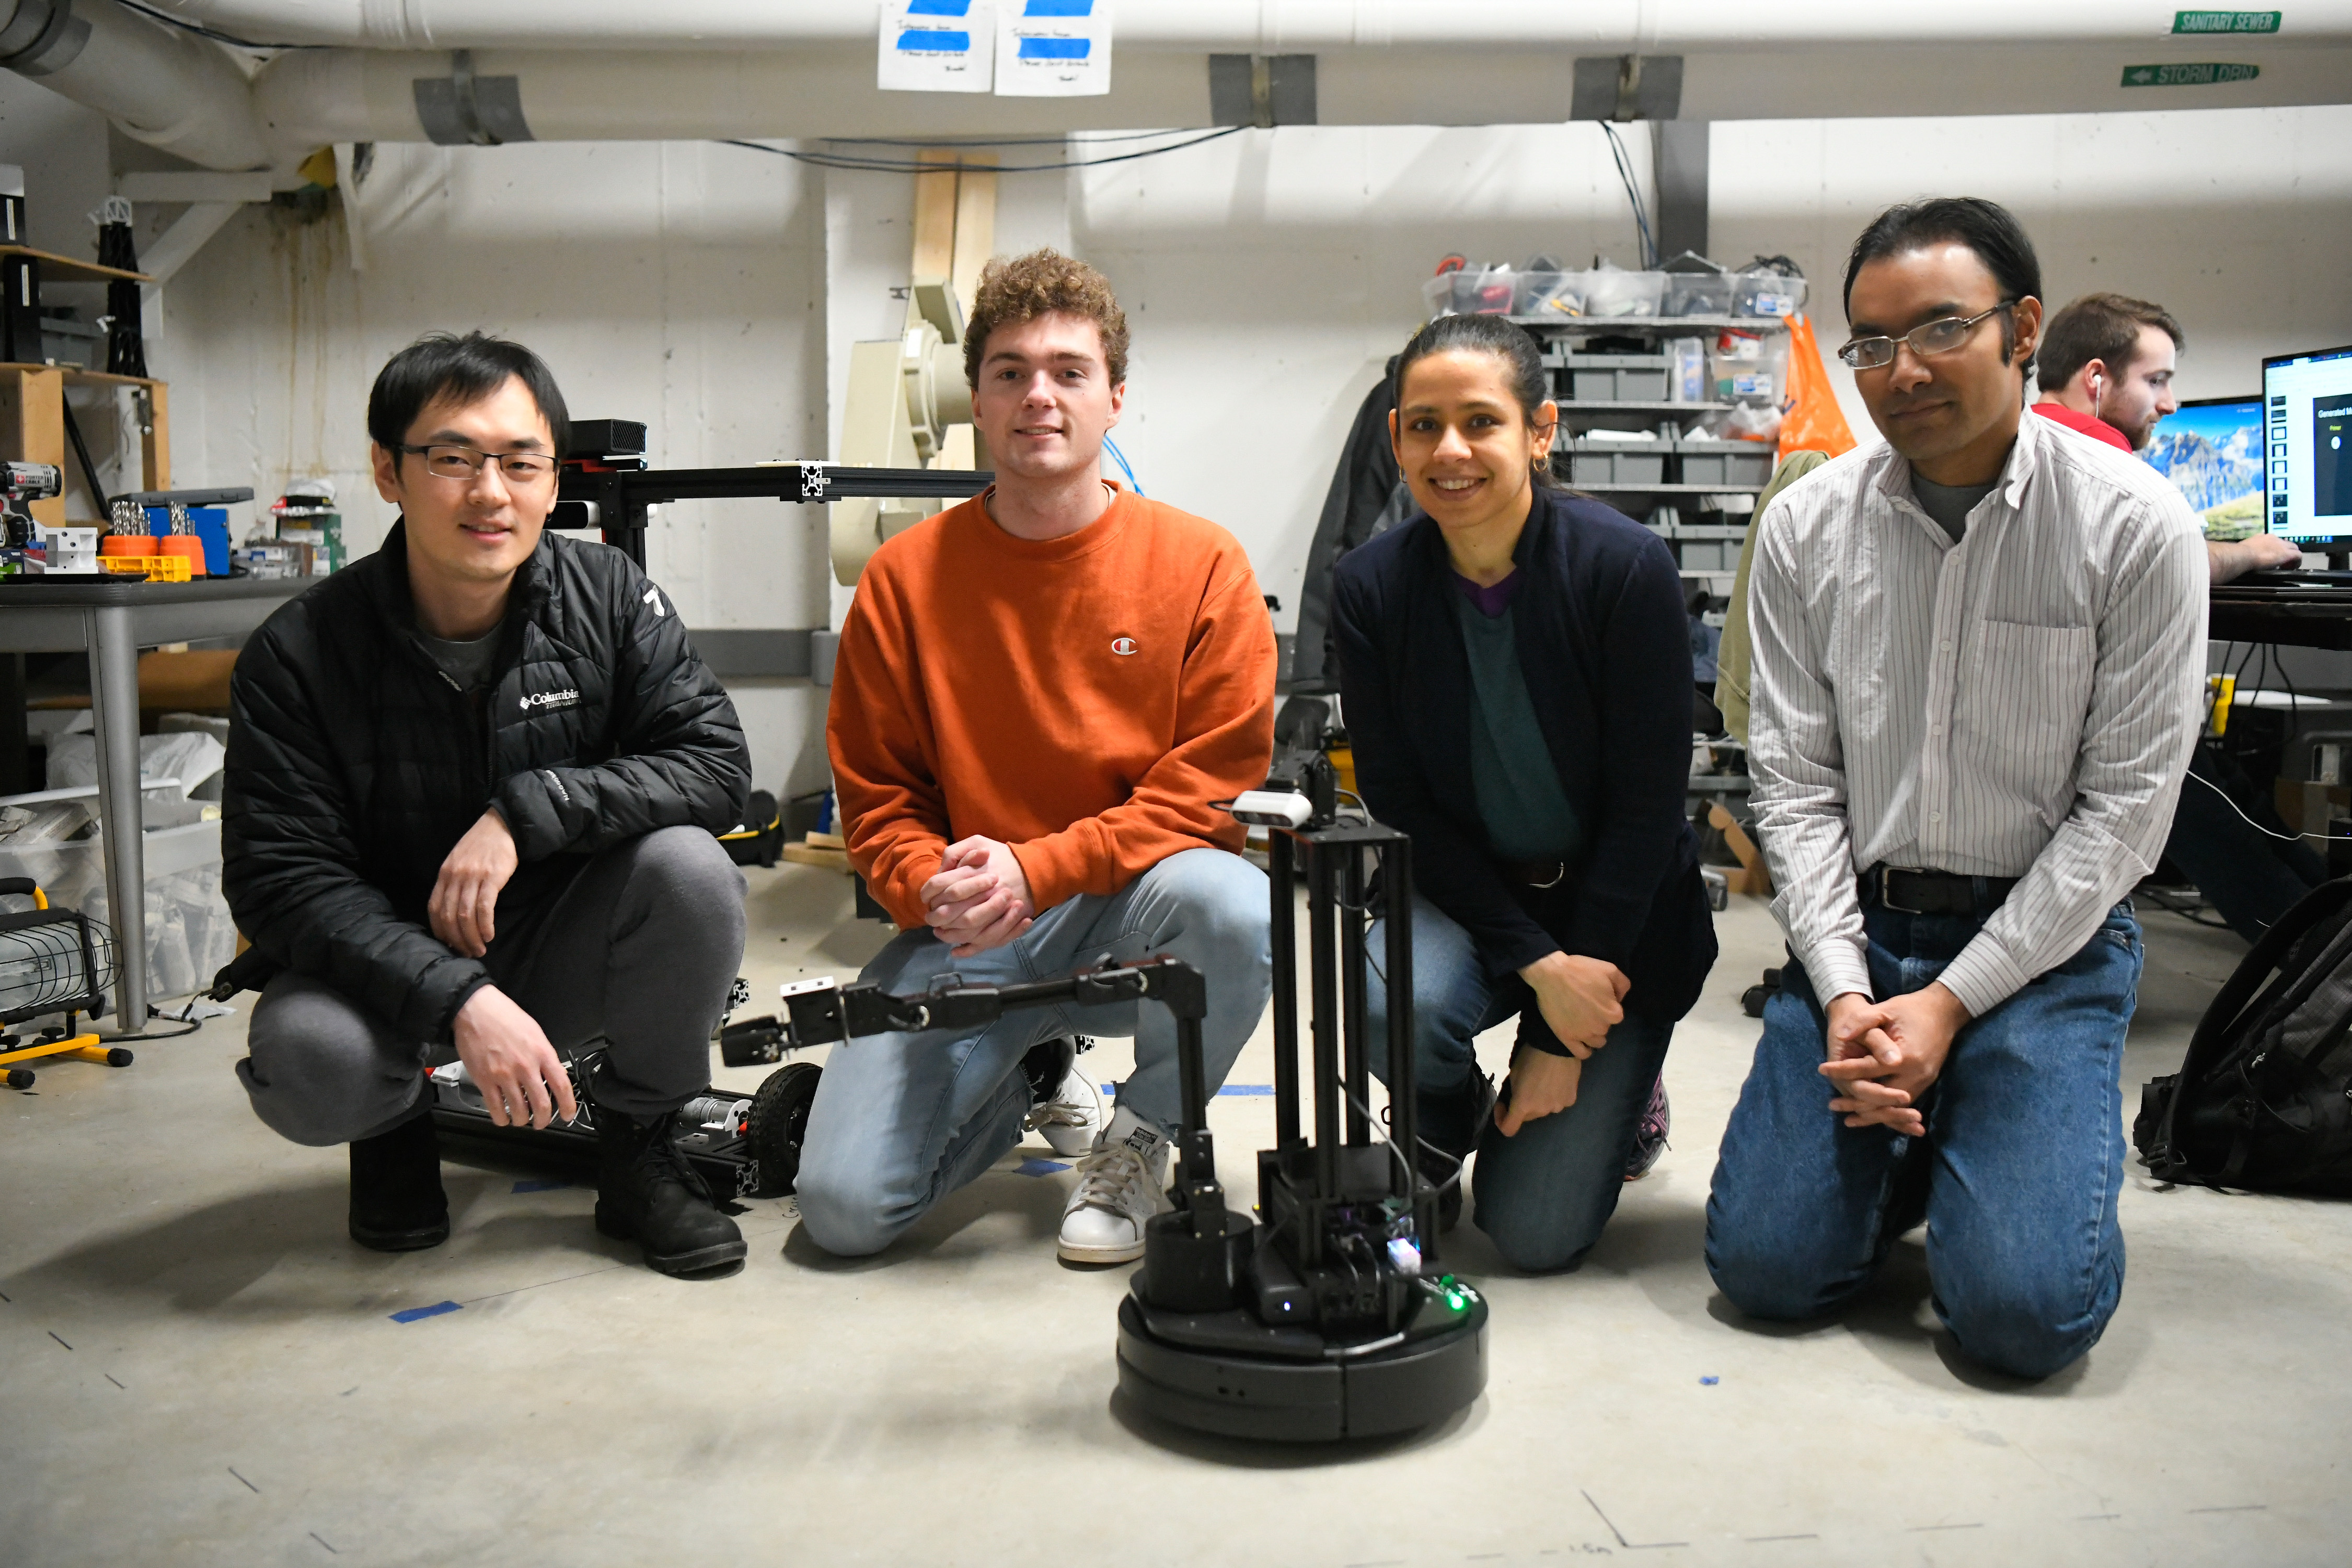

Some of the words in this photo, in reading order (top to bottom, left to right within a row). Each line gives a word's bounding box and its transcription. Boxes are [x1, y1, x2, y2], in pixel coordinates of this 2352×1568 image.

[2181, 13, 2234, 30] SANITARY
[2234, 13, 2274, 30] SEWER
[2158, 65, 2215, 85] STORM
[2218, 65, 2254, 82] DRN
[2318, 408, 2345, 418] Generated
[531, 689, 580, 705] Columbia
